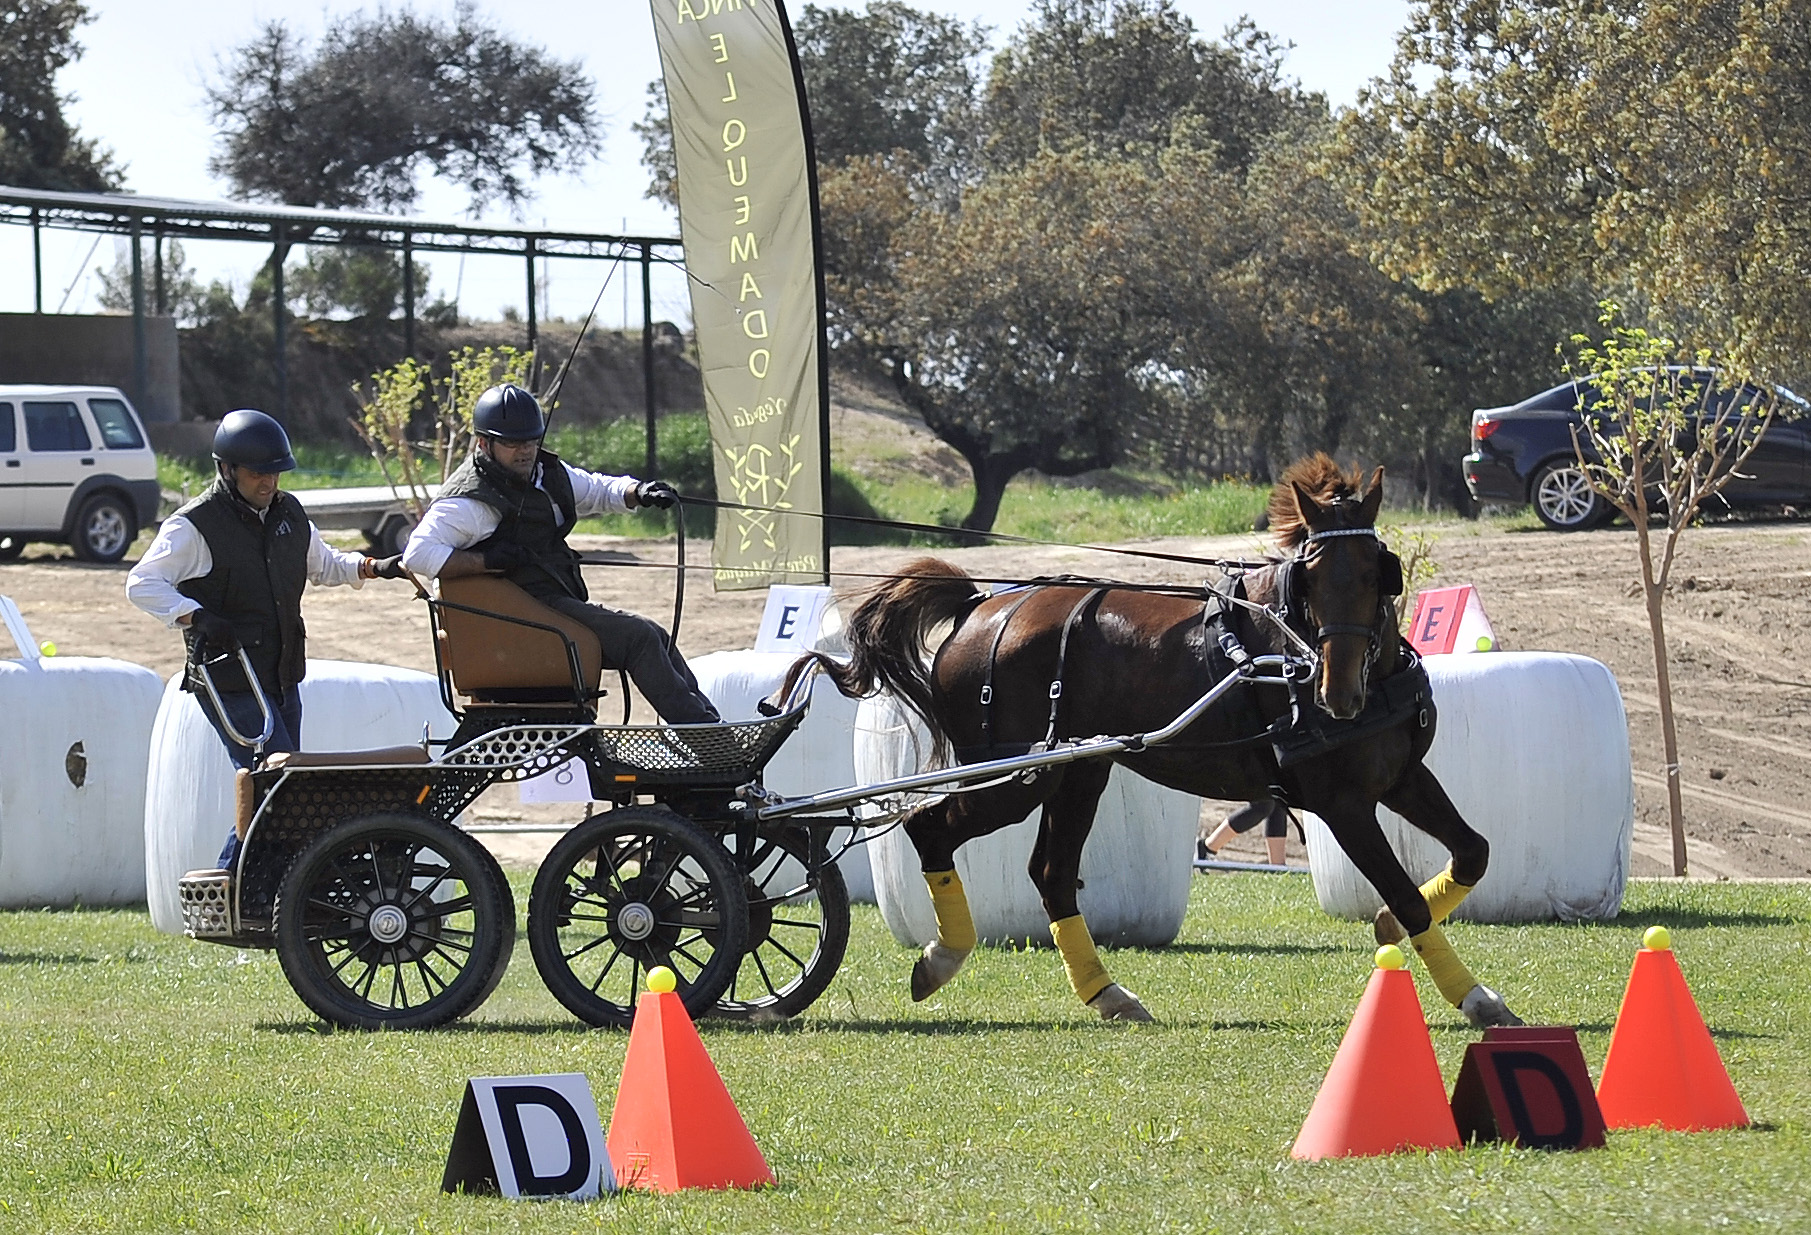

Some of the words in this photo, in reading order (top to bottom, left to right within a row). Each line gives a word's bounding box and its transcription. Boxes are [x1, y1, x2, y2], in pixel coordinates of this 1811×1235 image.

[776, 605, 800, 639] E
[1421, 605, 1444, 642] E
[1491, 1051, 1584, 1151] D
[492, 1085, 591, 1196] D
